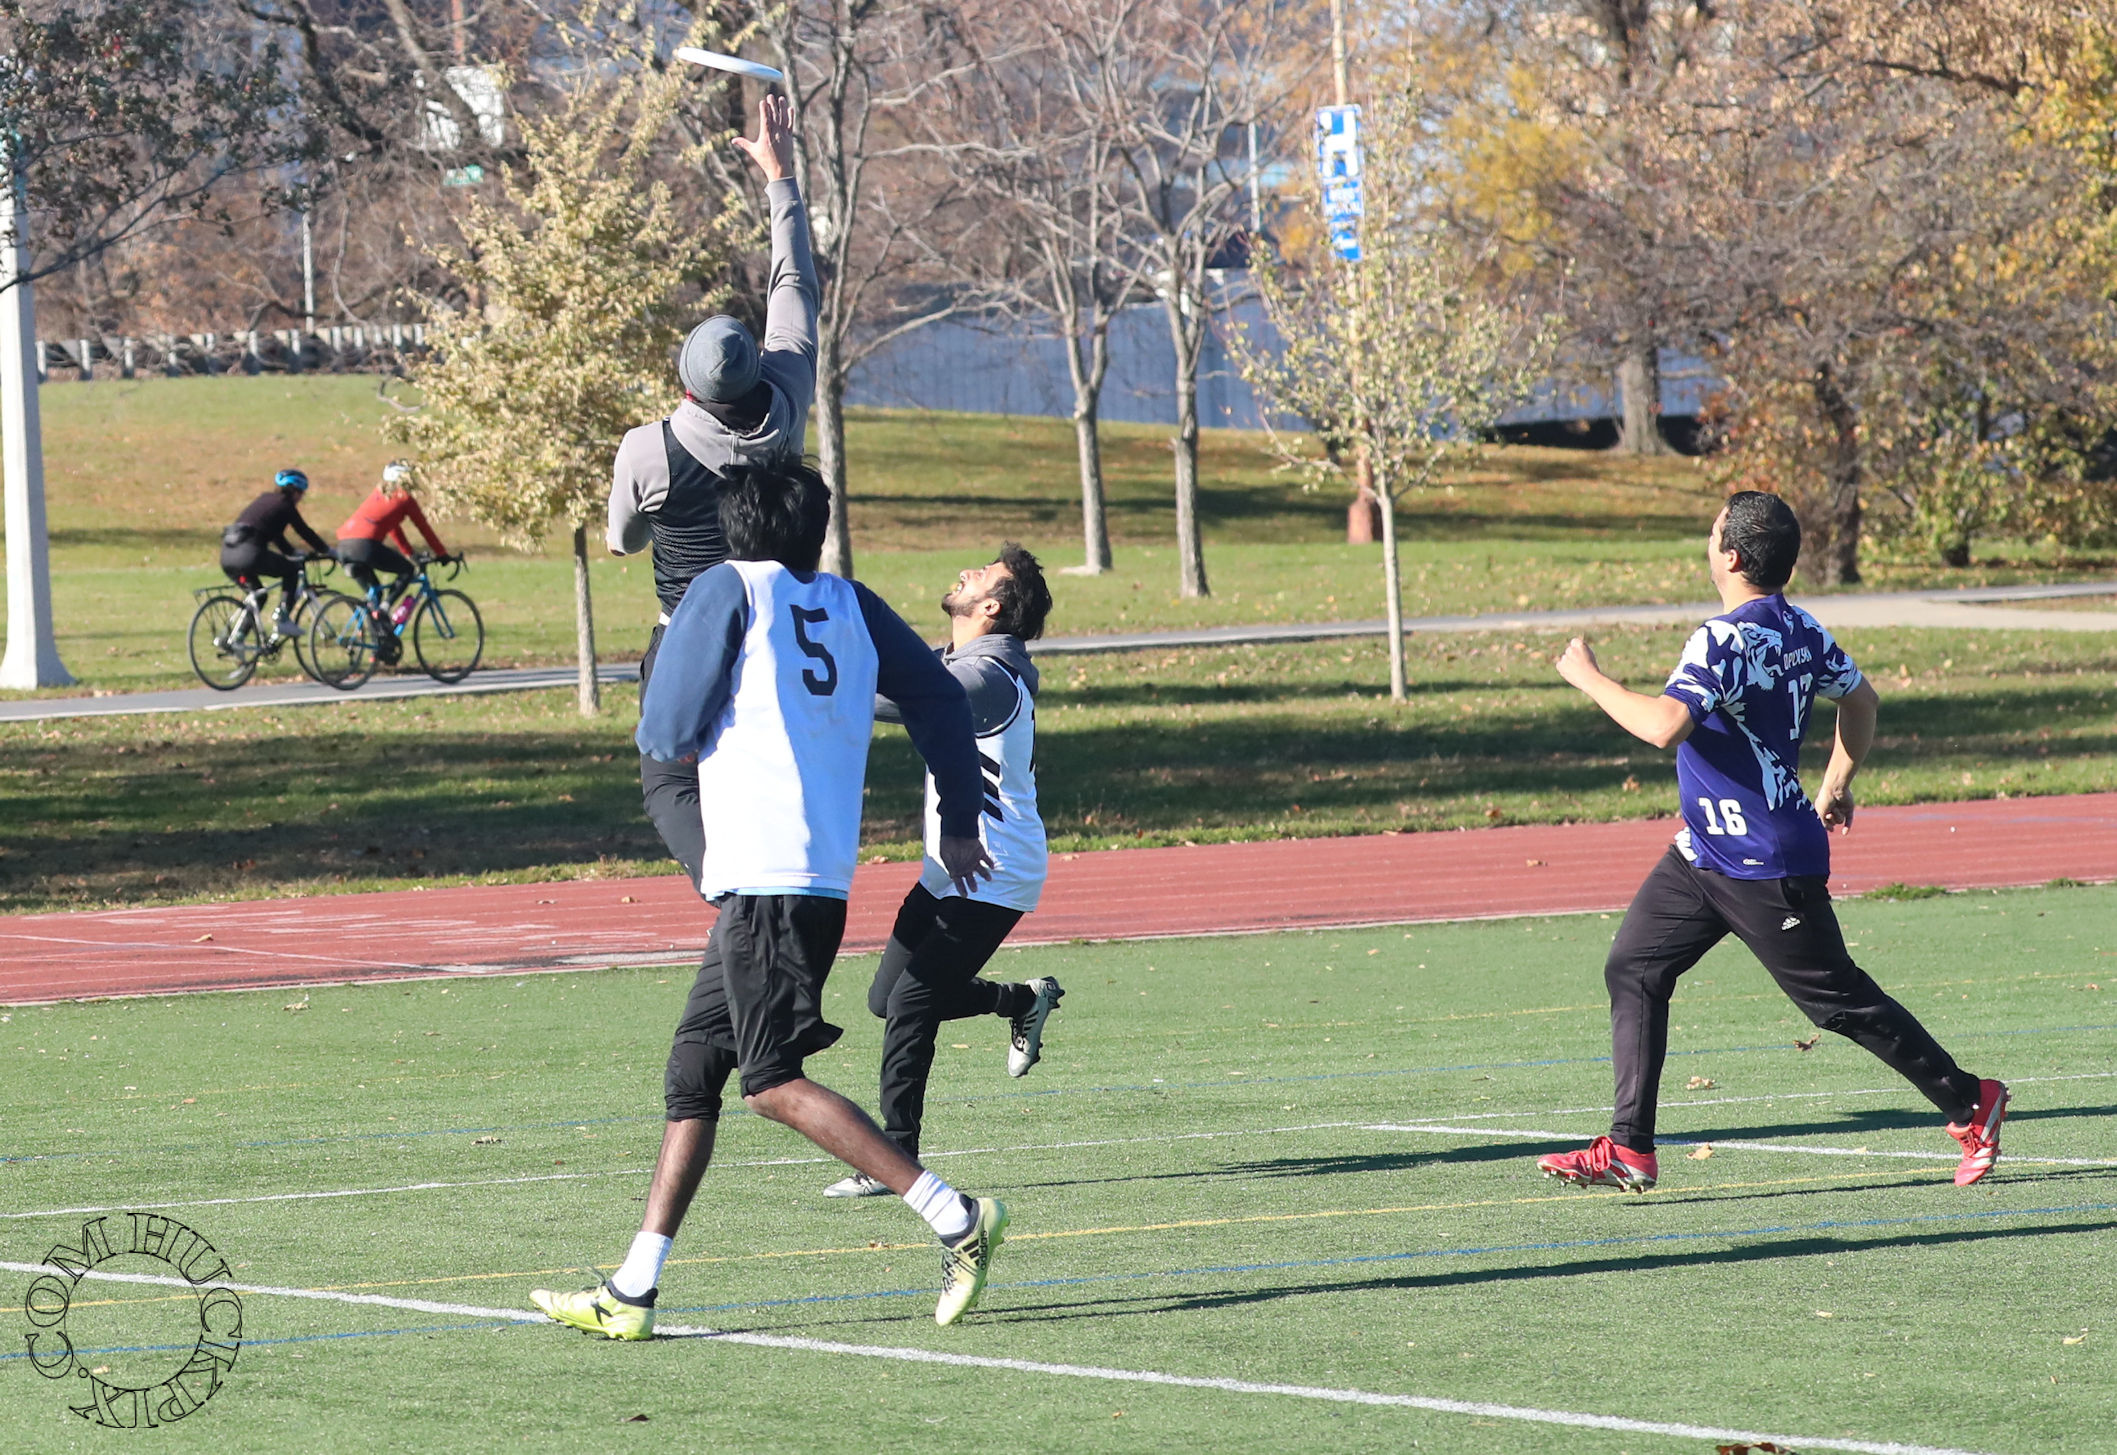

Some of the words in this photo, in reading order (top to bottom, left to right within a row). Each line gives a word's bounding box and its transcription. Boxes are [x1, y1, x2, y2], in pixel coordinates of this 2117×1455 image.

[790, 604, 838, 696] 5
[1699, 797, 1747, 835] 16
[979, 1230, 988, 1271] adidas
